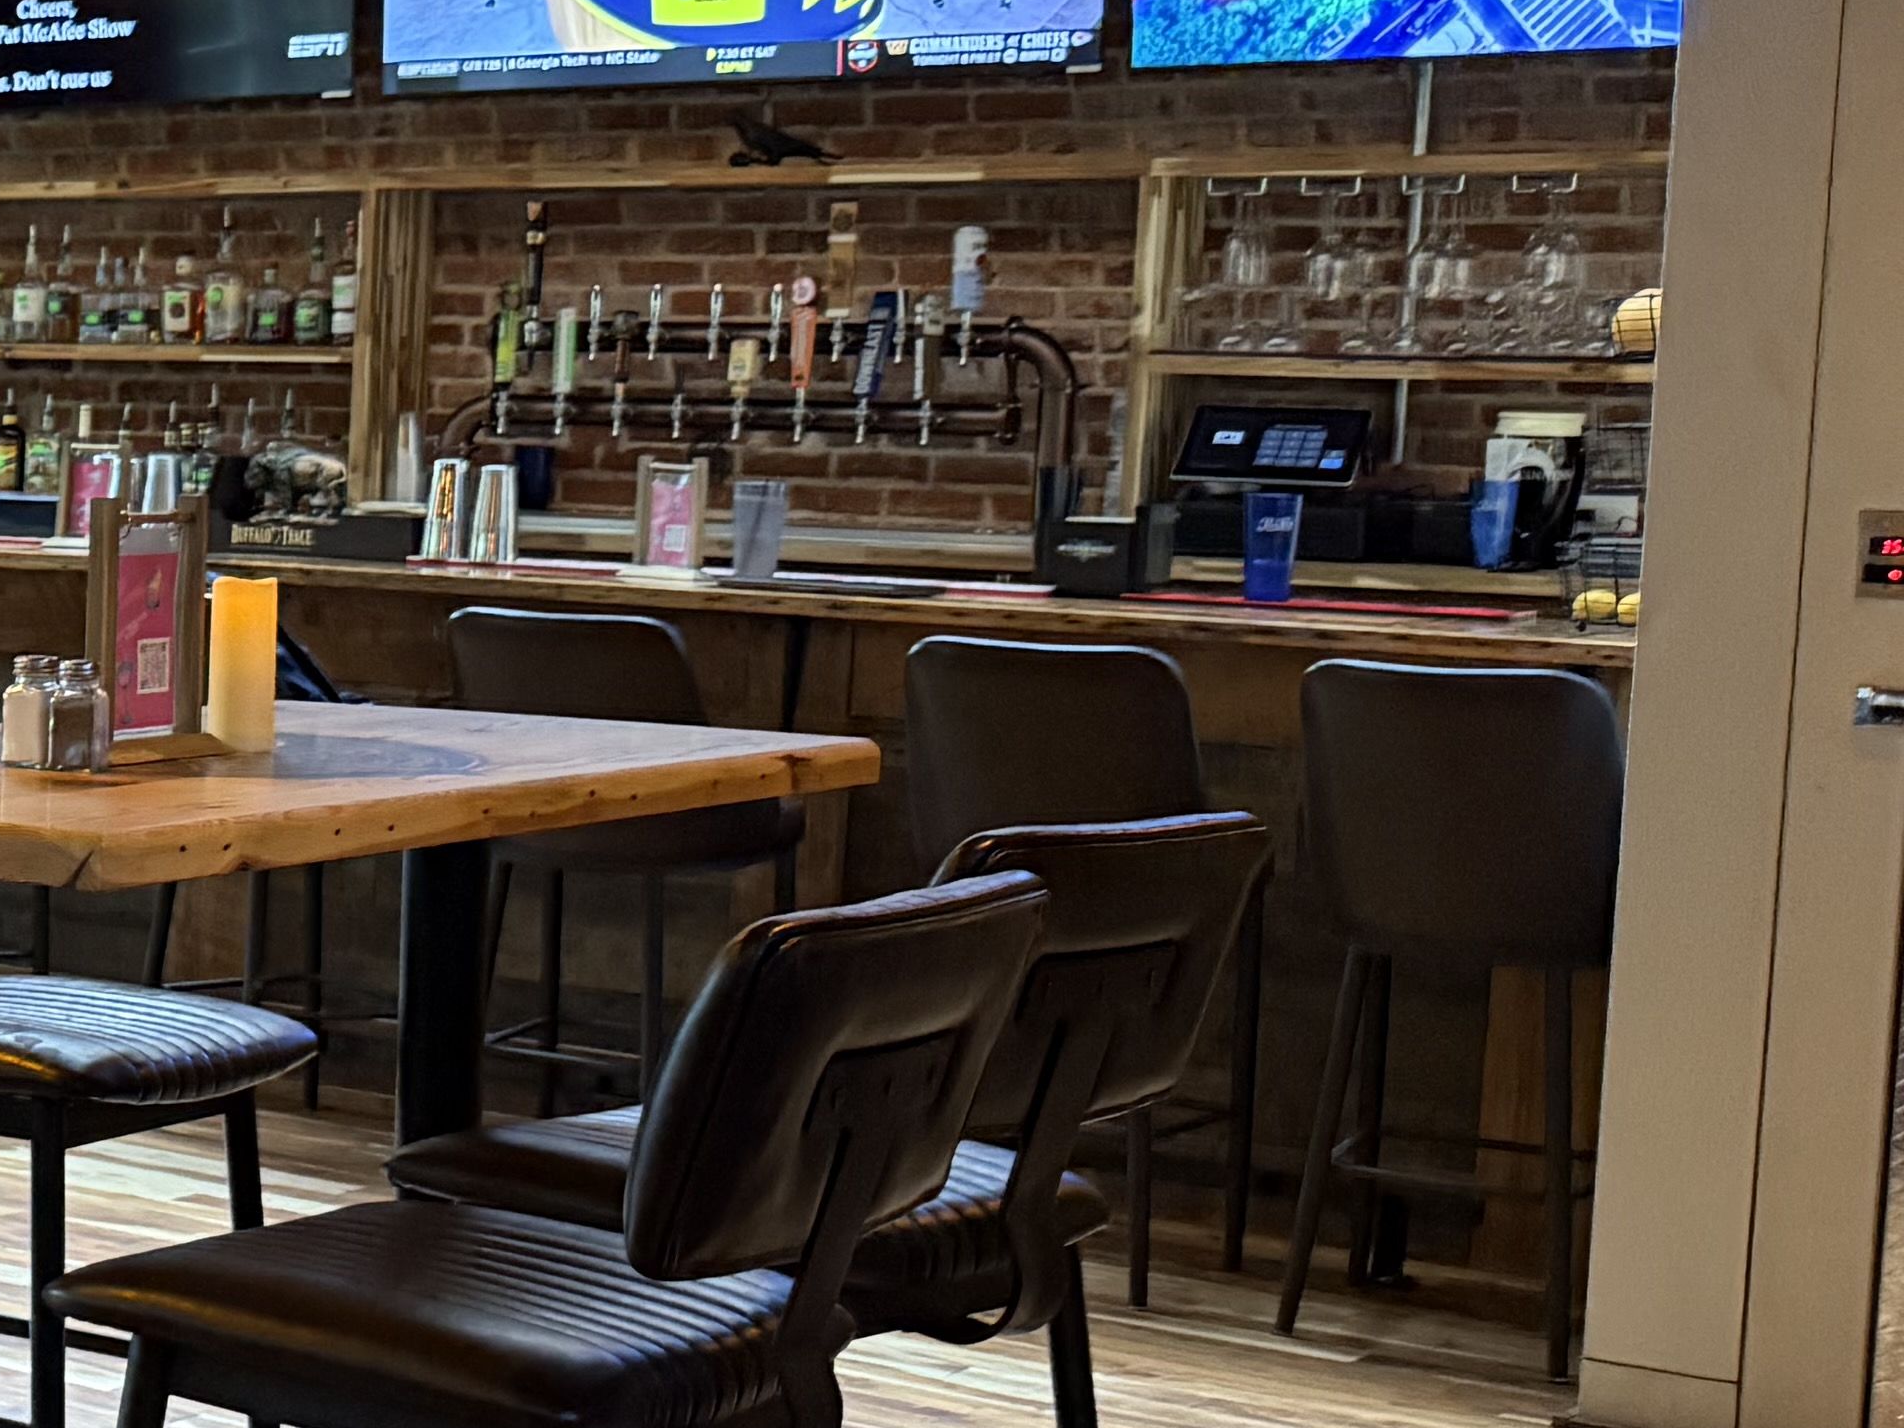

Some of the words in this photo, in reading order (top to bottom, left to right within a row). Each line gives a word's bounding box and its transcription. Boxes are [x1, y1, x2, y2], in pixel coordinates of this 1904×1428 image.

[22, 20, 86, 44] McAfee
[87, 16, 139, 40] Show
[288, 32, 349, 59] ESPN
[909, 34, 1005, 54] COMMANDERS
[1021, 31, 1070, 49] CHIEFS
[516, 56, 560, 71] Georgia
[561, 54, 588, 67] Tech
[625, 51, 662, 64] State
[60, 71, 90, 90] sue
[91, 70, 113, 88] us
[231, 524, 272, 545] BUFFALO
[282, 525, 315, 546] TRACE
